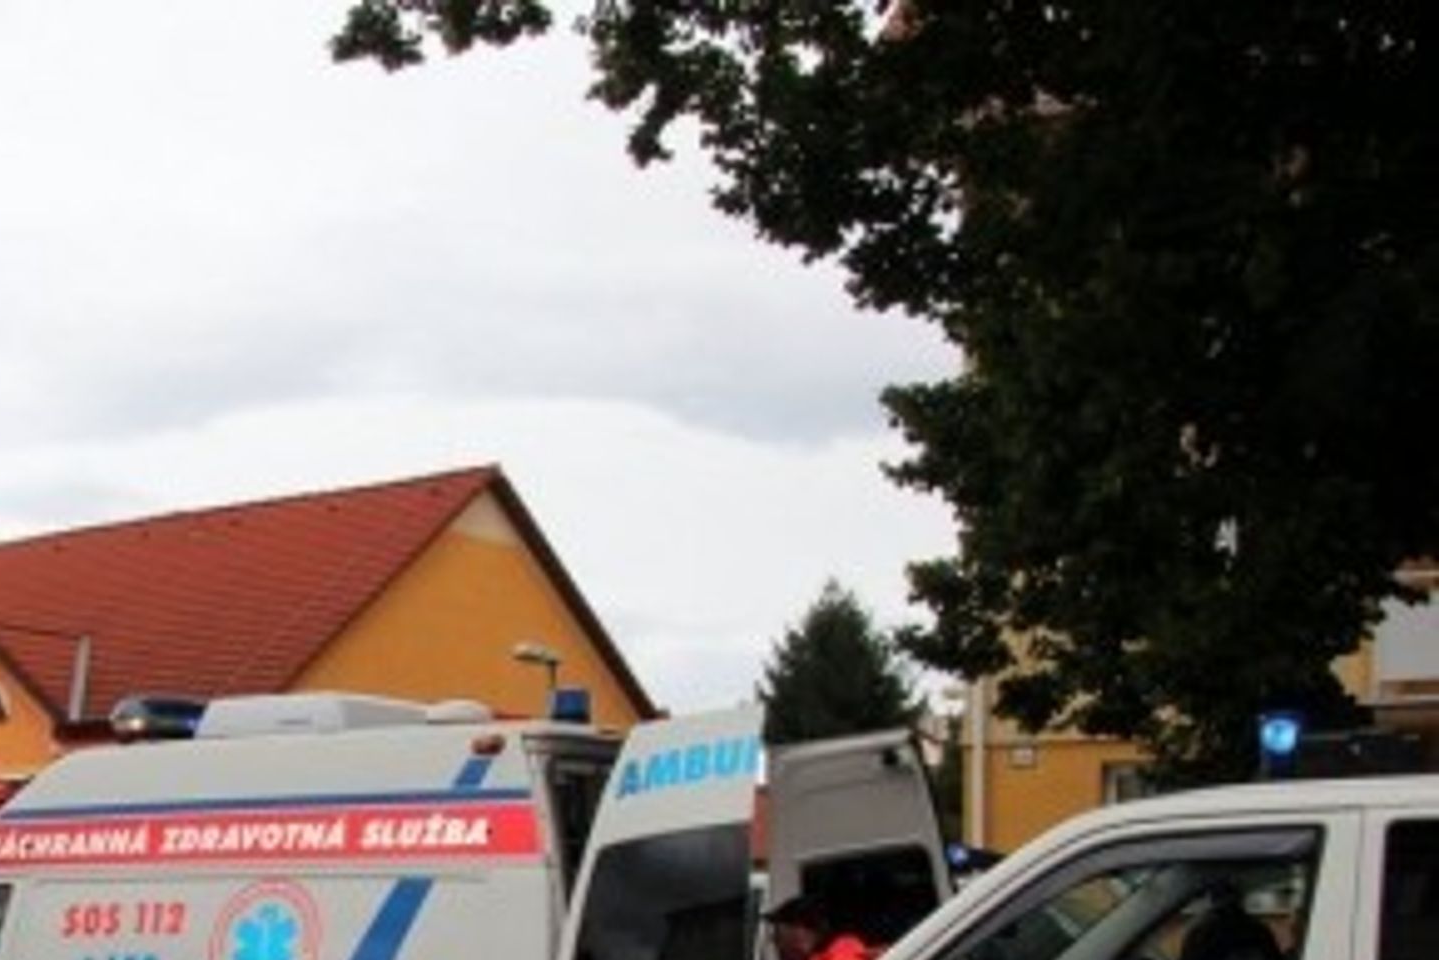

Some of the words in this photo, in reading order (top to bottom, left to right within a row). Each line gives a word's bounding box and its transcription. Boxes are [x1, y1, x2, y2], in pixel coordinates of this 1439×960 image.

[162, 812, 347, 852] ZDRAVOTNÁ
[361, 812, 488, 846] SLUŽBA
[63, 903, 122, 937] SOS
[134, 902, 186, 935] 112
